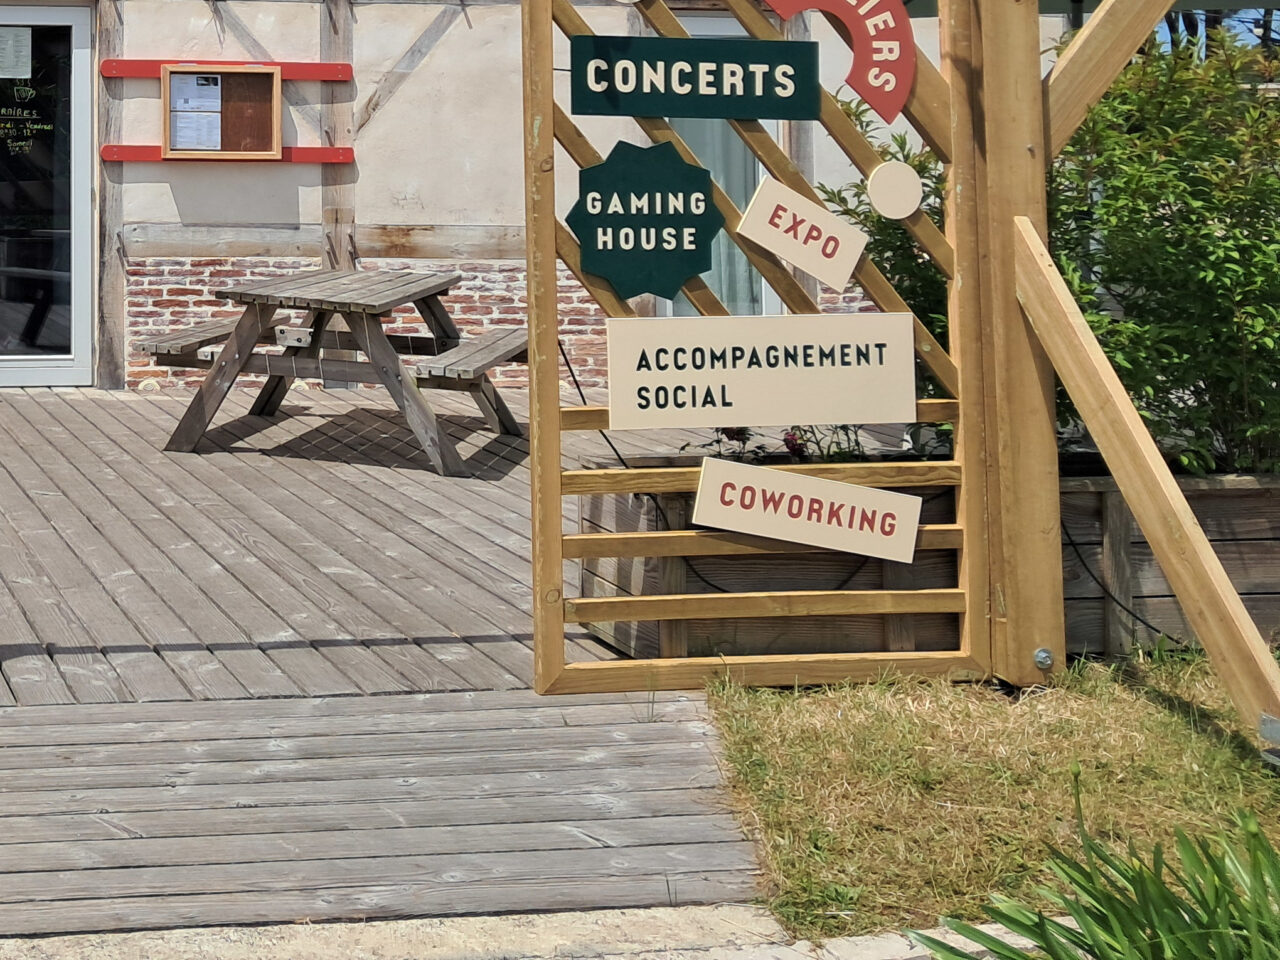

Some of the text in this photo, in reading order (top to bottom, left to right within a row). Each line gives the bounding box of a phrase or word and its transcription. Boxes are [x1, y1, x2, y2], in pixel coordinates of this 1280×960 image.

[586, 58, 797, 98] CONCERTS
[586, 191, 707, 216] GAMING
[596, 226, 697, 251] HOUSE
[767, 204, 841, 260] EXPO
[636, 342, 888, 372] ACCOMPAGNEMENT
[636, 384, 734, 410] SOCIAL
[719, 481, 897, 537] COWORKING
